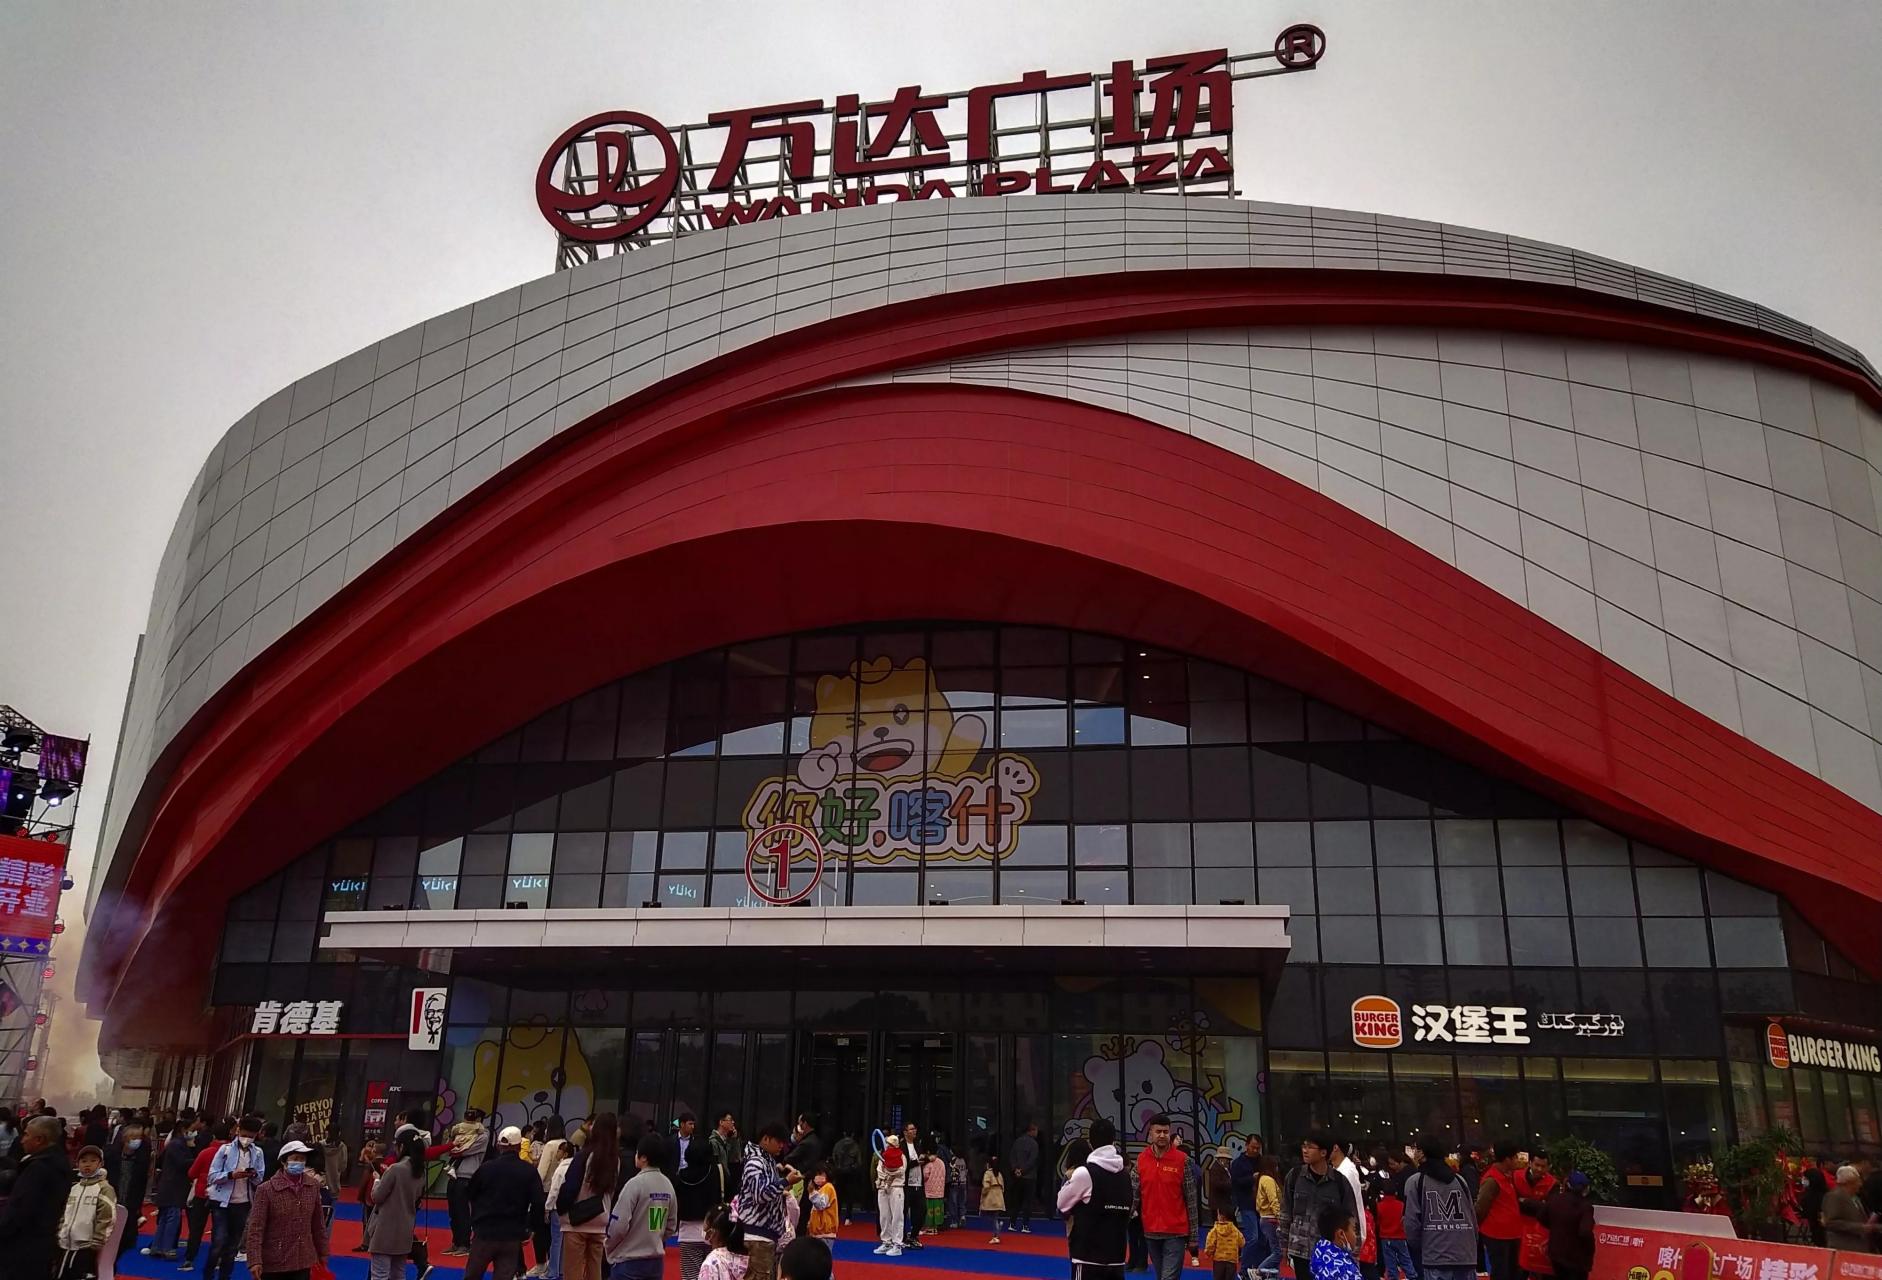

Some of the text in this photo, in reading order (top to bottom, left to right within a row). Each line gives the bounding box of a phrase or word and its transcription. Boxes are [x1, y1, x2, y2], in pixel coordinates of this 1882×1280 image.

[708, 48, 1233, 190] 万达广场
[702, 147, 1234, 229] WANDA PLAZA
[251, 1000, 344, 1034] 肯德基
[1354, 1012, 1399, 1023] BURGER
[1355, 1023, 1400, 1037] KING
[1411, 1004, 1531, 1044] 汉堡王
[1787, 1034, 1881, 1073] BURGER KING
[649, 1207, 668, 1231] W
